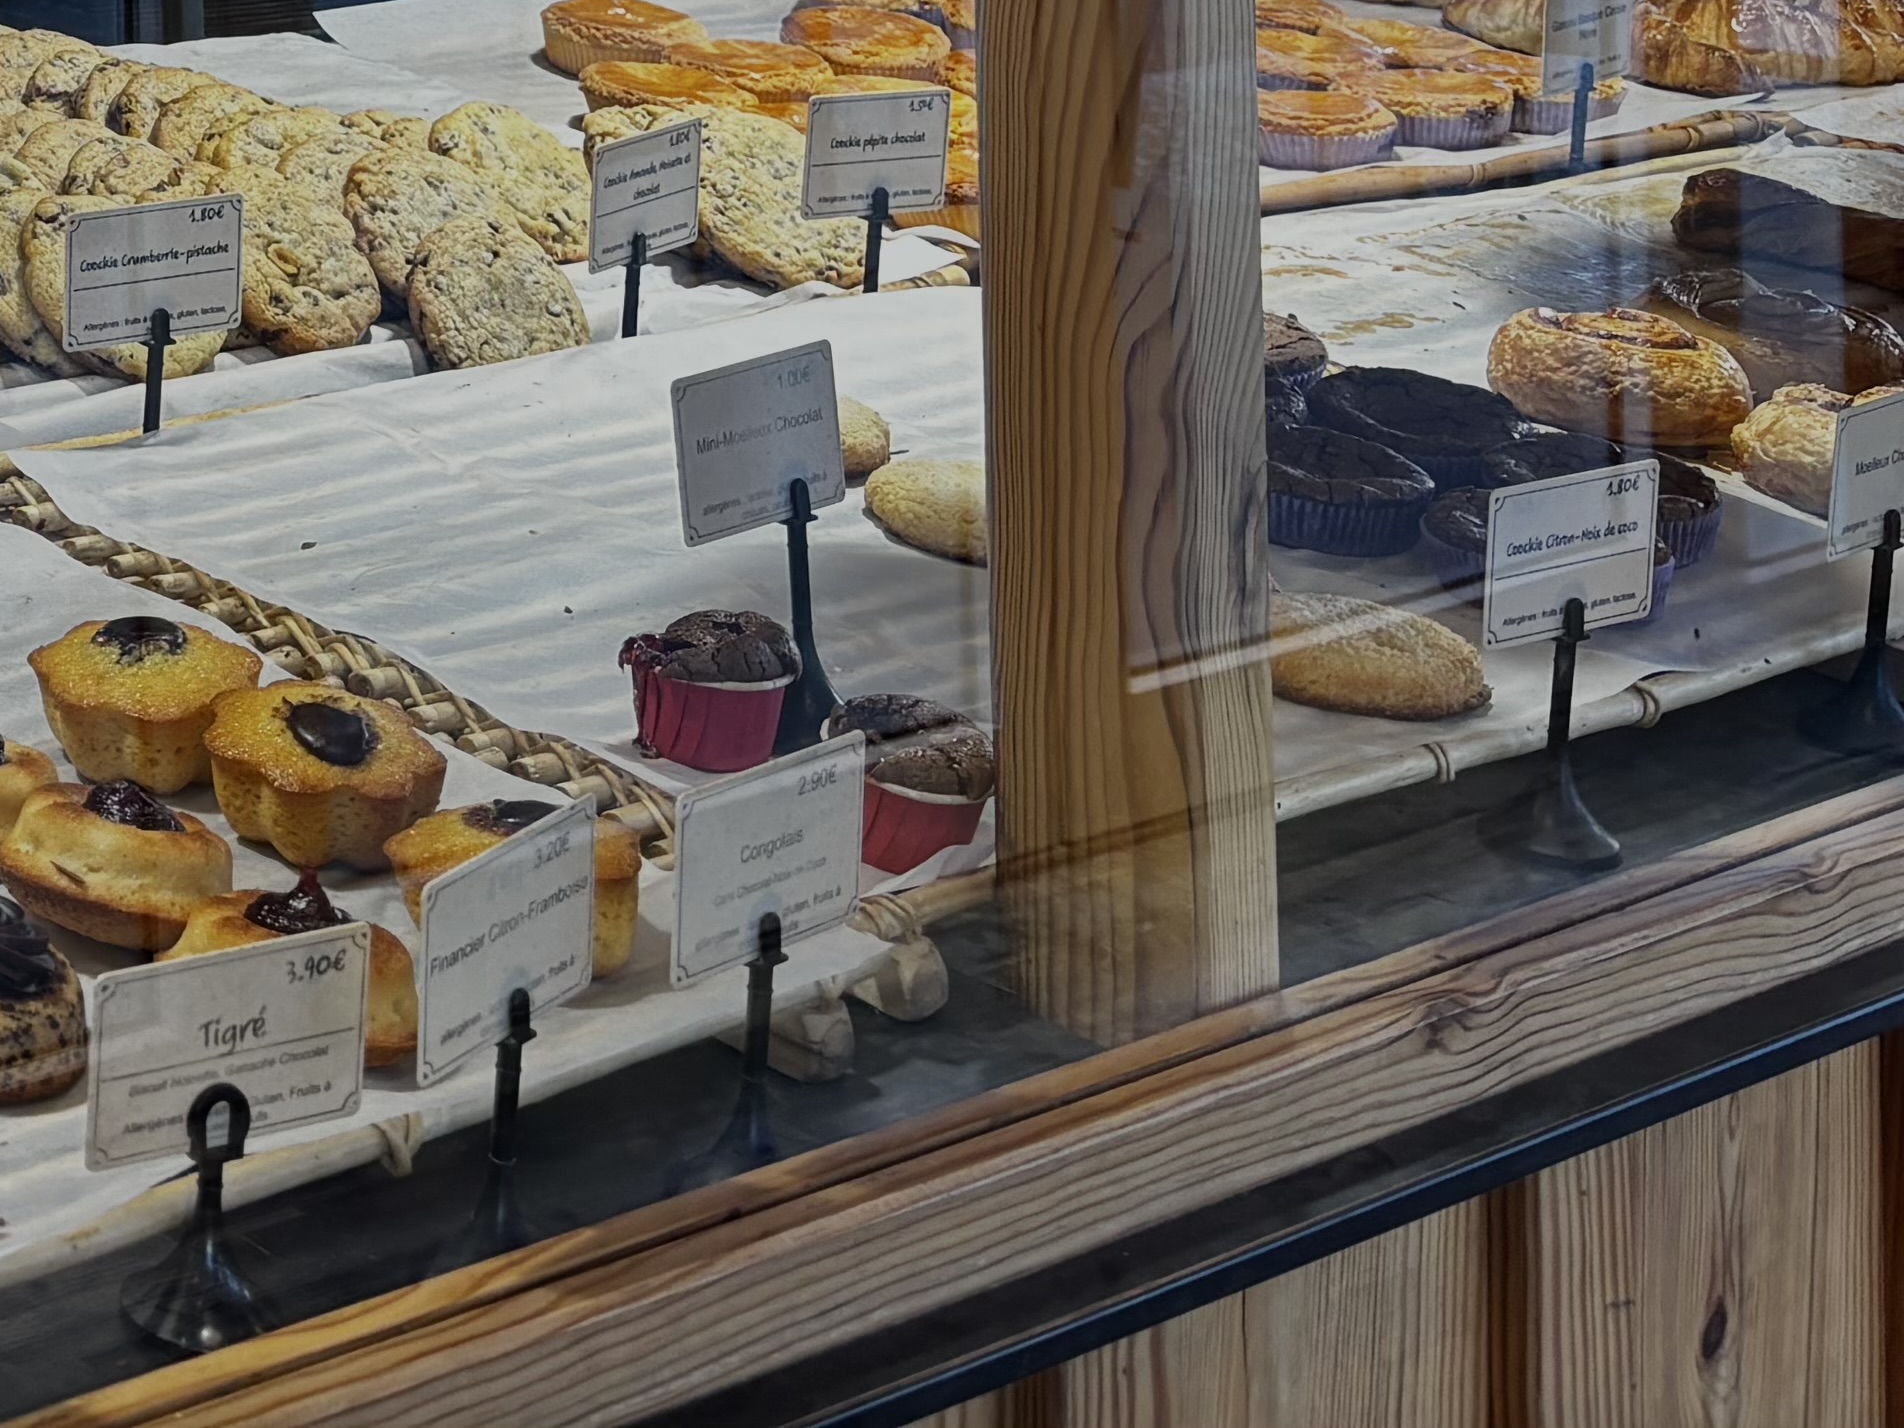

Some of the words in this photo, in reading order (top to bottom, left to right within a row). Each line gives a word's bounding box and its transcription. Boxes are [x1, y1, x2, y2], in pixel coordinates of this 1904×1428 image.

[187, 205, 225, 224] 1.80€
[774, 405, 824, 434] Chocolat
[1605, 475, 1641, 496] 1.80€
[1603, 520, 1616, 537] de
[1617, 520, 1640, 535] coco
[797, 763, 838, 797] 2.90€
[739, 827, 805, 865] Congolais
[285, 948, 347, 984] 3.90€
[429, 931, 486, 979] Financier
[198, 1004, 268, 1057] Tigré
